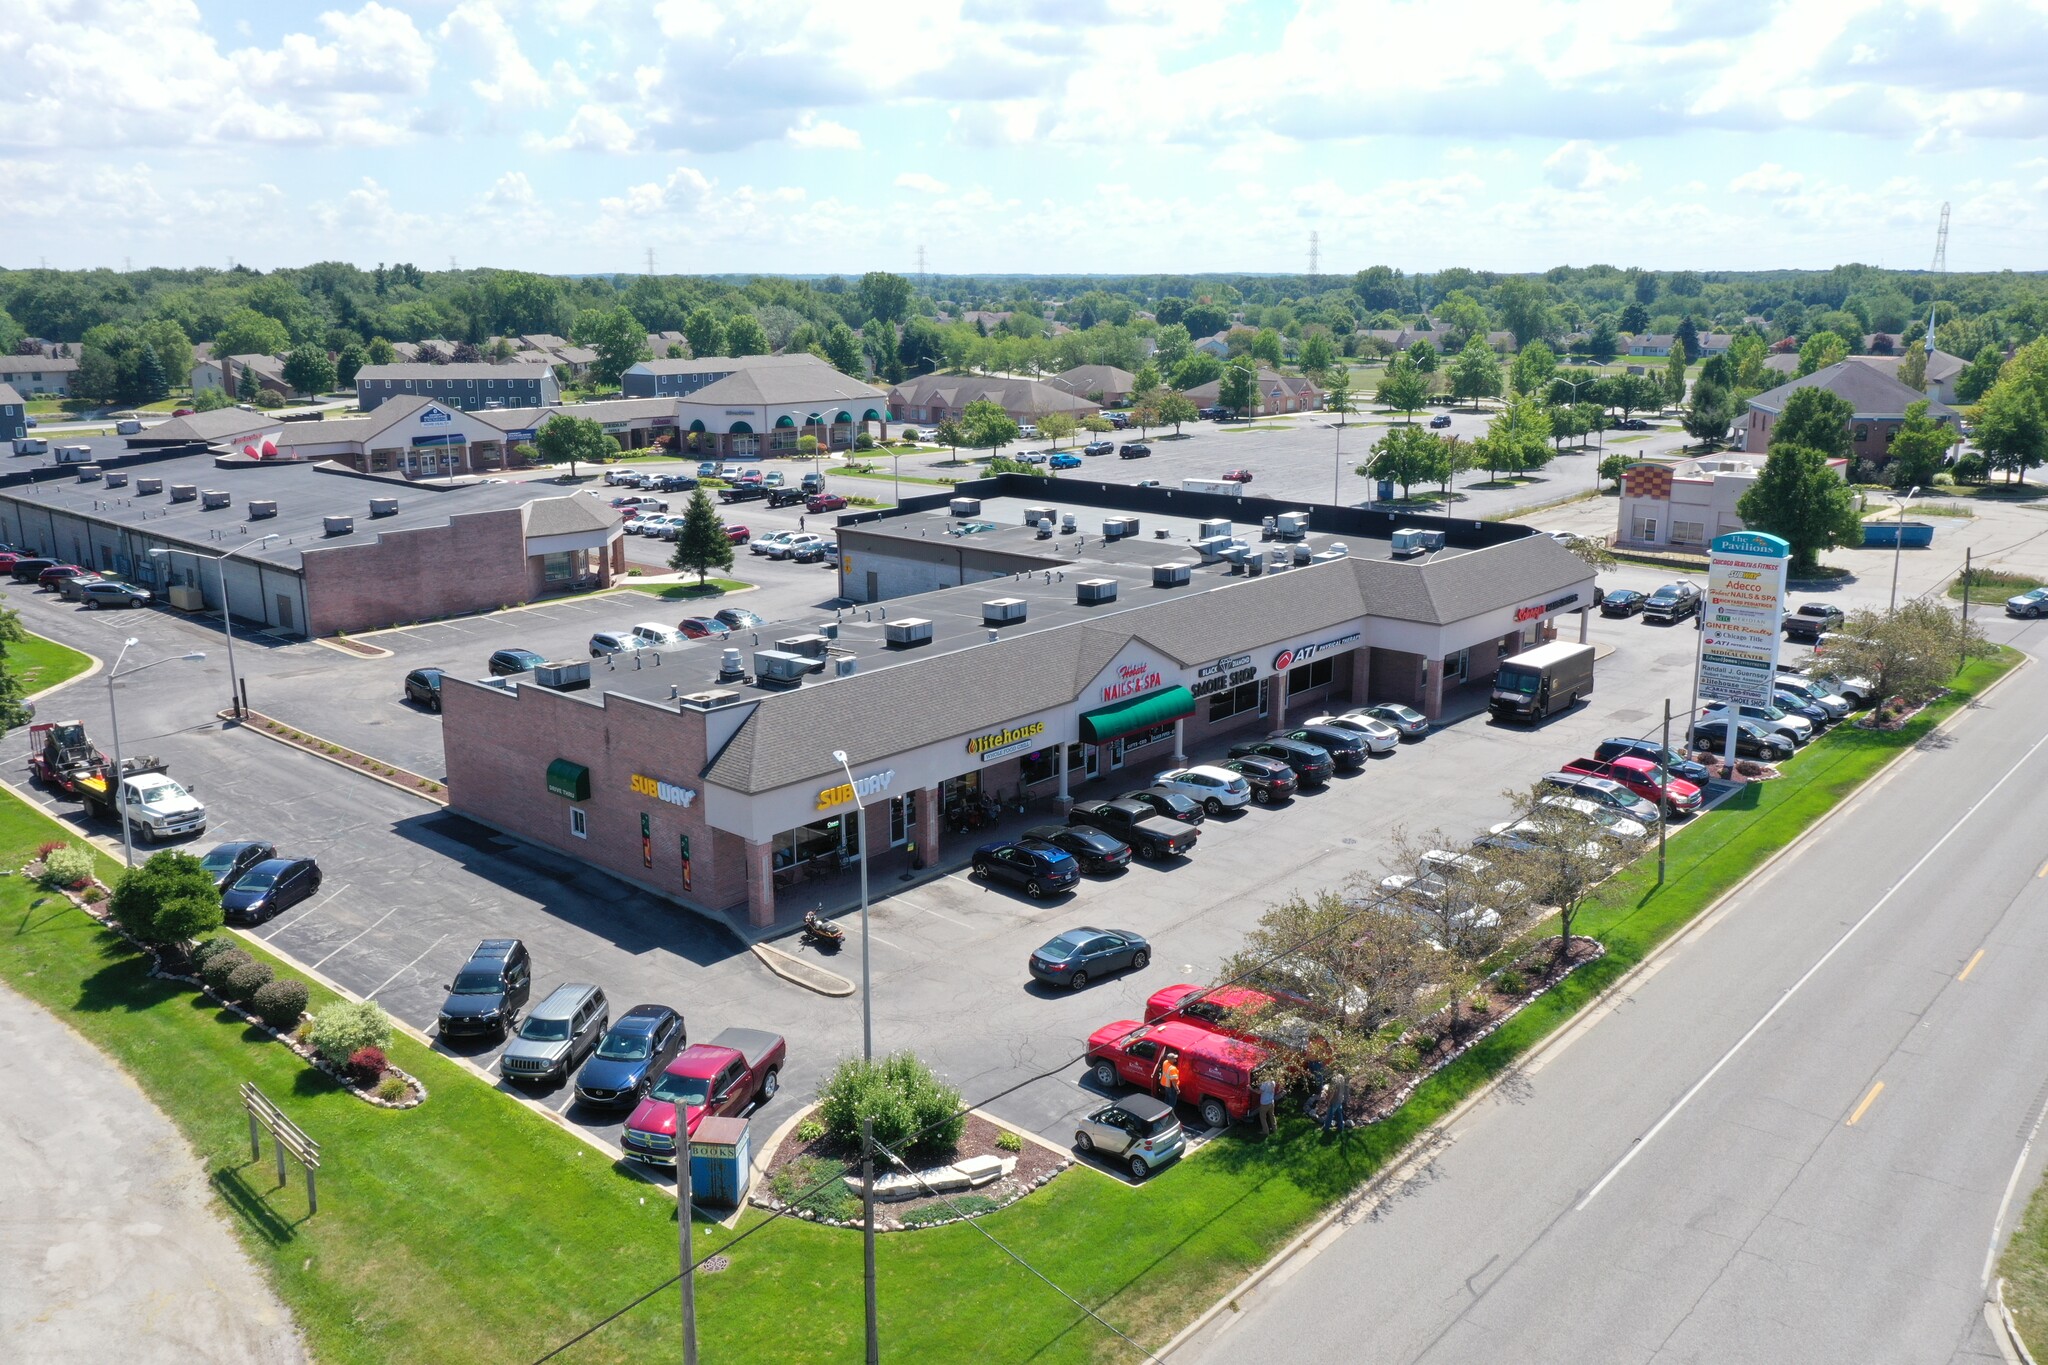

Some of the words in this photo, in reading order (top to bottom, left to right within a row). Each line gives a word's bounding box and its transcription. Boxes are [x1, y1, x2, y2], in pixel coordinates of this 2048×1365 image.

[1732, 535, 1748, 543] The
[1722, 541, 1774, 553] Pavilions
[1712, 558, 1733, 567] CHICAGO
[1757, 562, 1779, 571] FITNESS
[1728, 570, 1761, 580] SUBWAY
[1726, 580, 1762, 592] Adecco
[1709, 588, 1730, 597] Hobart
[1730, 592, 1754, 600] NAILS
[1712, 597, 1743, 605] BRICKYARD
[1732, 616, 1766, 625] MERIDIAN
[1706, 621, 1740, 631] GINTER
[1741, 626, 1773, 637] Realty
[1723, 632, 1747, 641] Chicago
[1750, 635, 1763, 643] Title
[1293, 644, 1317, 663] ATI
[1319, 640, 1341, 652] PHYSICAL
[1341, 634, 1361, 645] THERAPY
[1711, 649, 1739, 658] MEDICAL
[1118, 662, 1147, 679] Hobart
[1202, 665, 1218, 677] BLACK
[1232, 656, 1250, 668] DIAMOND
[1702, 665, 1727, 673] Randall
[1736, 669, 1769, 680] Guernsey
[1103, 680, 1133, 702] NAILS
[1134, 678, 1141, 692] &
[1144, 672, 1161, 690] SPA
[1191, 675, 1228, 698] SMOKE
[1229, 666, 1257, 686] SHOP
[1706, 678, 1740, 688] litehouse
[1730, 696, 1749, 705] SMOKE
[1751, 699, 1767, 707] SHOP
[977, 721, 1046, 753] litehouse
[985, 750, 1003, 760] WHOLE
[1003, 745, 1017, 755] FOOD
[549, 784, 563, 794] DRIVE
[630, 773, 696, 808] SUBWAY
[816, 770, 895, 811] SUBWAY
[692, 1147, 734, 1156] BOOKS
